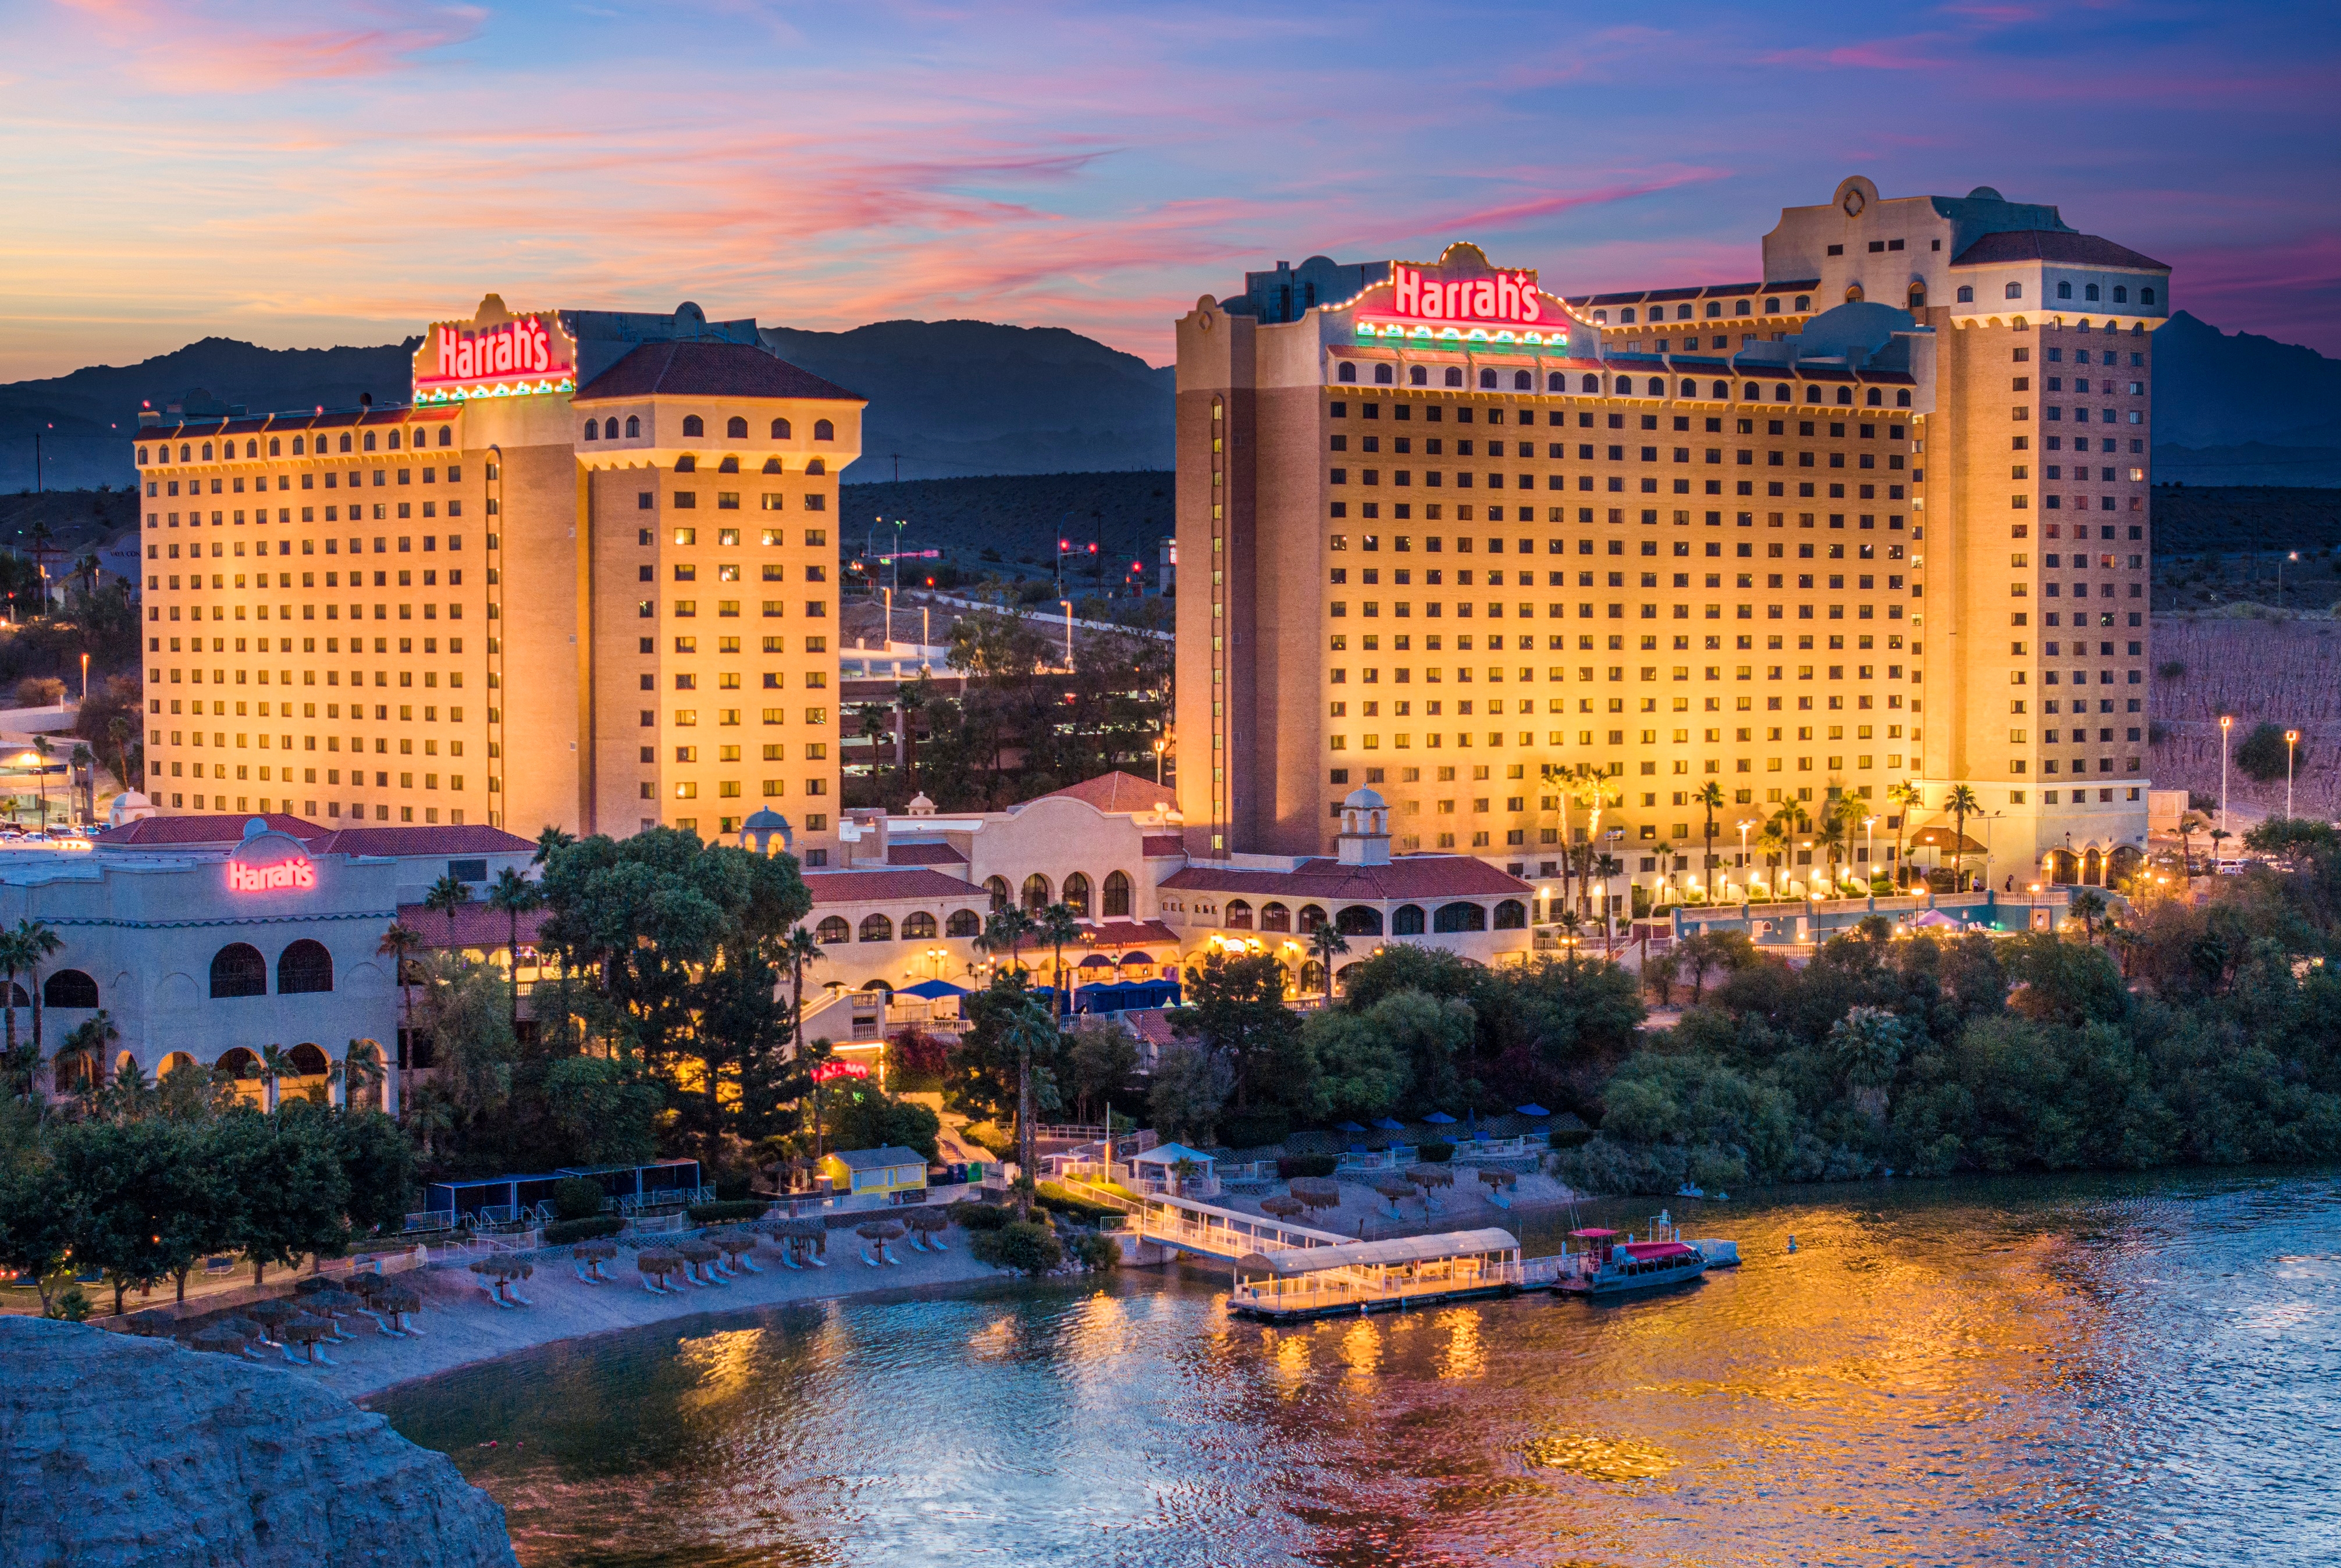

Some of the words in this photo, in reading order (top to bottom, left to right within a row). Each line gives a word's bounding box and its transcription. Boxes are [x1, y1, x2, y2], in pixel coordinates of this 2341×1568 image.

[1396, 265, 1540, 322] Harrah's
[439, 315, 549, 377] Harrah's
[229, 857, 314, 890] Harrah's
